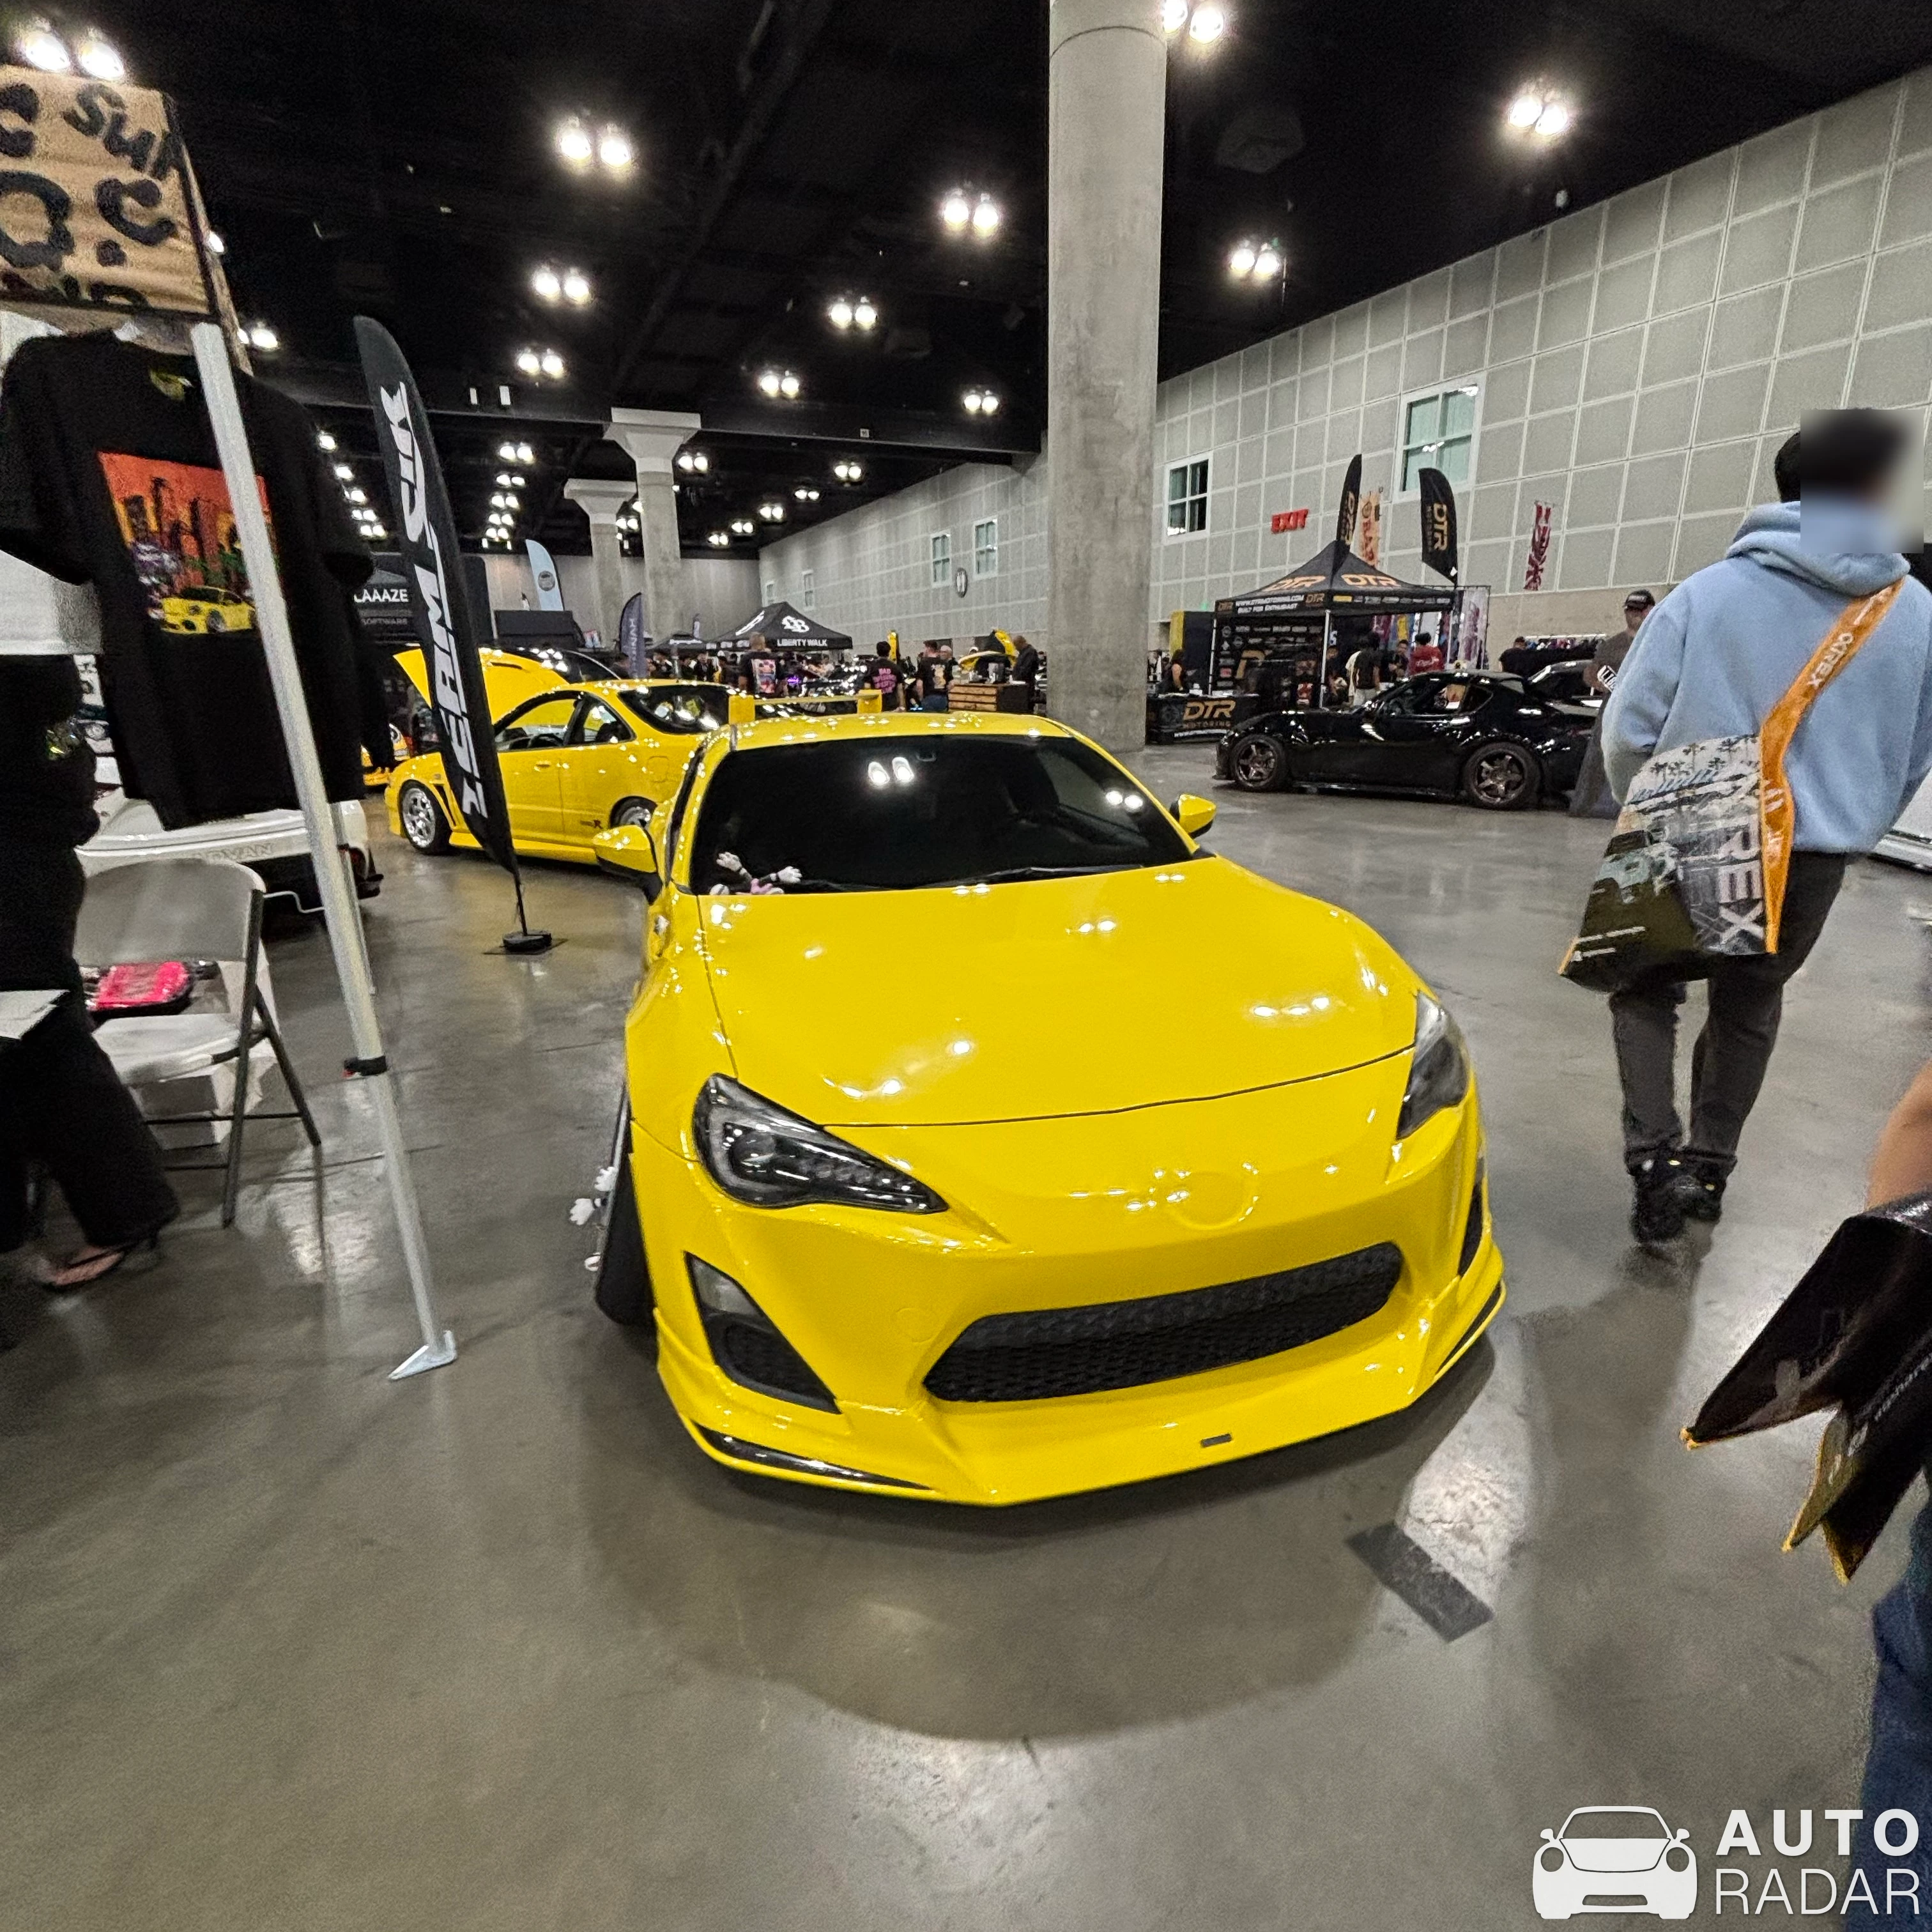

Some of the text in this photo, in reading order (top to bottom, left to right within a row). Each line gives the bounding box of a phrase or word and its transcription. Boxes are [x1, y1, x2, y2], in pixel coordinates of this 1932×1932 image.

[380, 381, 434, 549] SIK
[1432, 503, 1448, 551] DTR
[1341, 574, 1402, 587] DTR
[414, 543, 488, 818] TEAM
[1183, 699, 1236, 720] DTR
